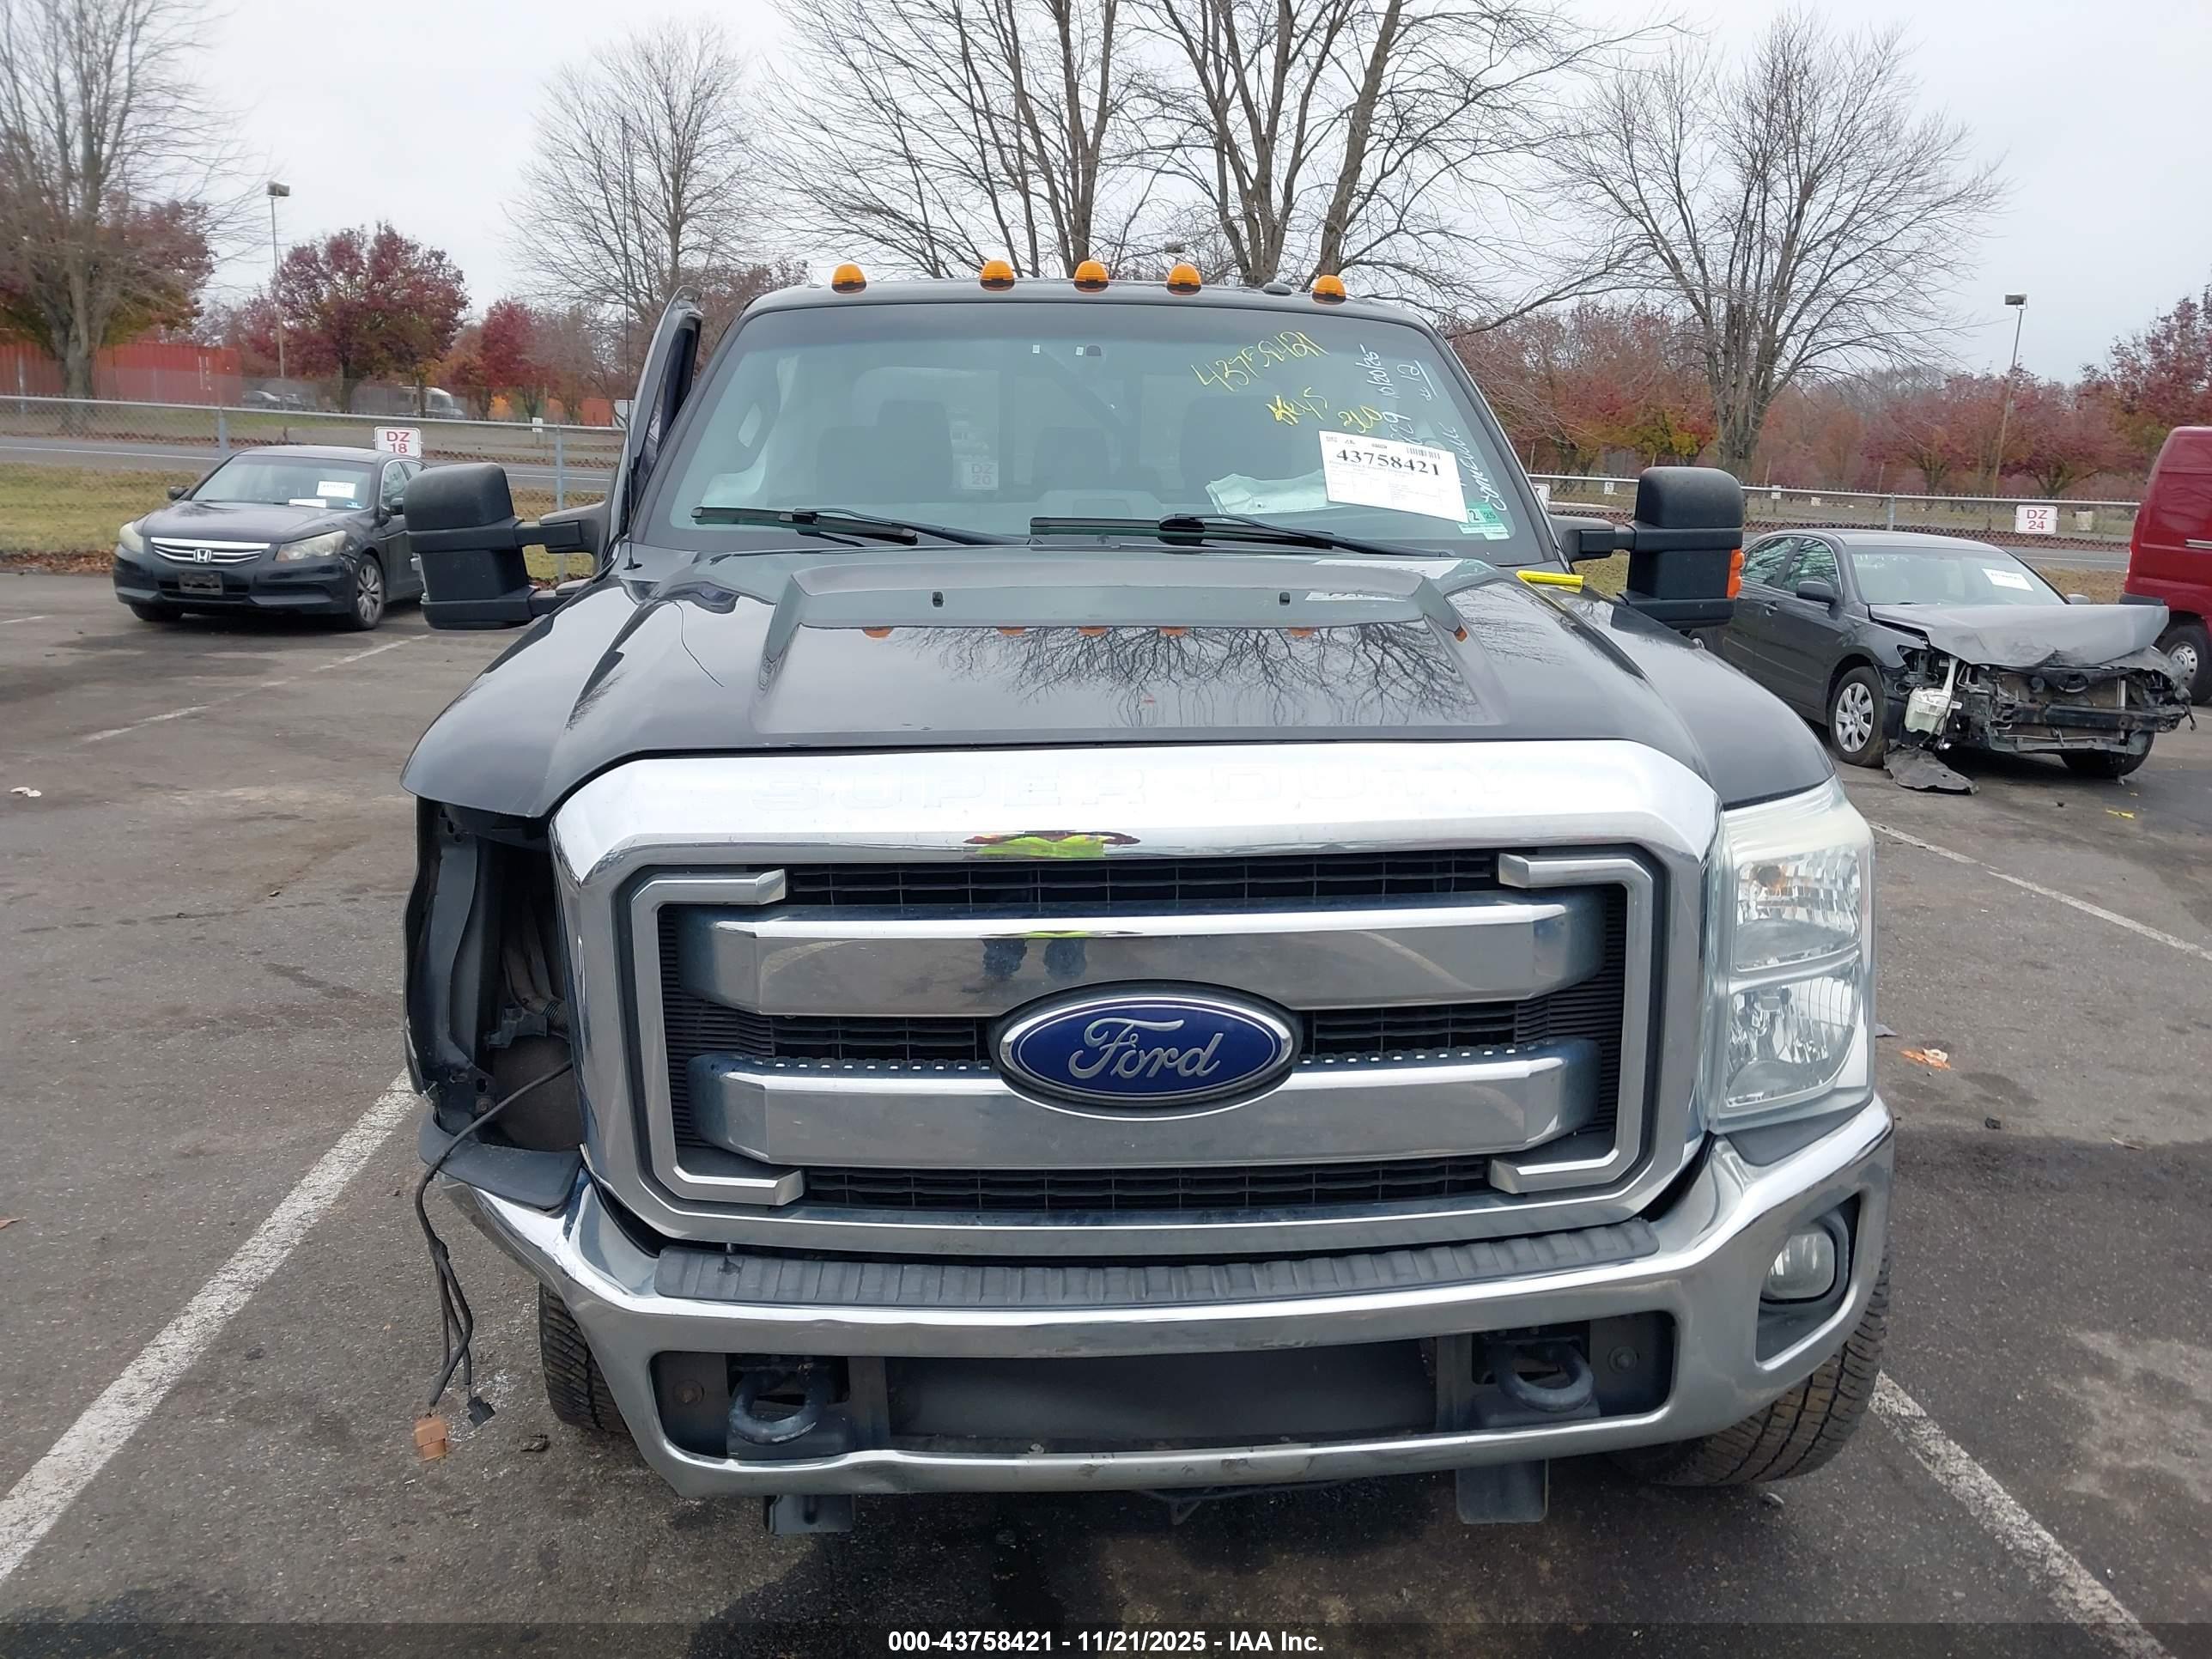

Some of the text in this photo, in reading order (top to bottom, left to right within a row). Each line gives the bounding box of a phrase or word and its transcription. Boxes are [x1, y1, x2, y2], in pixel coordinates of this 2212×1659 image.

[386, 431, 410, 442] DZ
[390, 442, 407, 453] 18
[1336, 448, 1440, 477] 43758421
[971, 464, 994, 475] DZ
[1468, 509, 1480, 521] 2
[1483, 511, 1497, 520] 25
[2027, 509, 2048, 520] DZ
[2027, 520, 2045, 530] 24
[750, 767, 1146, 813] SUPER
[1068, 1018, 1224, 1079] Ford
